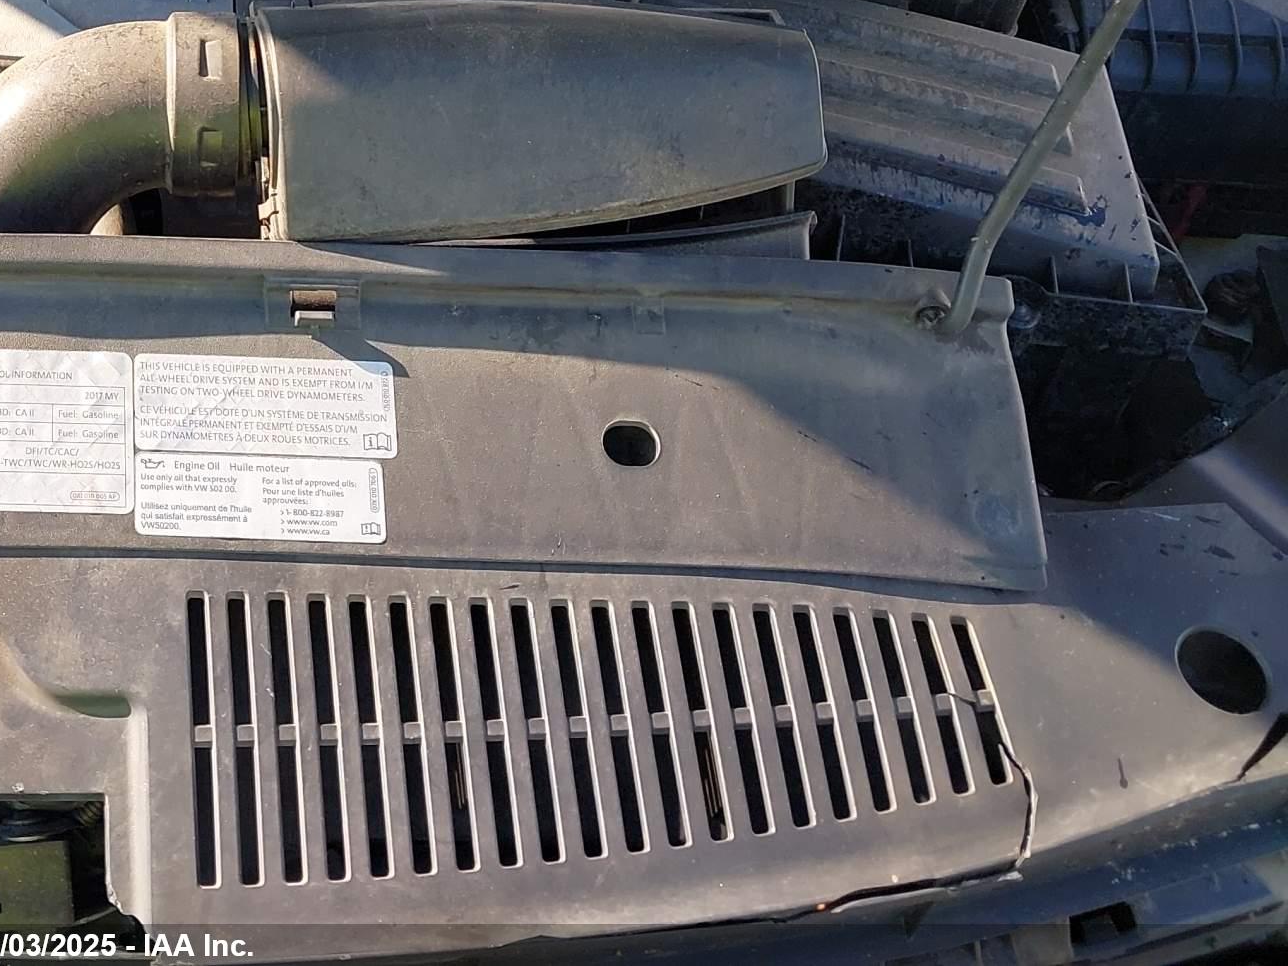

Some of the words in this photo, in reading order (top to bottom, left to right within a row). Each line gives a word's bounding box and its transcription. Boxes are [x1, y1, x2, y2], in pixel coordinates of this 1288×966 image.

[140, 361, 161, 371] THIS
[162, 362, 200, 372] VEHICLE
[202, 363, 210, 372] IS
[212, 363, 259, 374] EQUIPPED
[260, 365, 285, 374] WITH
[287, 366, 294, 375] A
[297, 366, 353, 377] PERMANENT
[11, 370, 73, 380] INFORMATION
[140, 373, 190, 384] ALL-WHEEL
[192, 375, 220, 384] DRIVE
[222, 376, 256, 385] SYSTEM
[258, 377, 279, 386] AND
[281, 378, 290, 387] IS
[292, 378, 327, 388] EXEMPT
[329, 380, 356, 389] FROM
[85, 391, 103, 400] 2017
[105, 392, 120, 400] MY
[140, 385, 178, 395] TESTING
[179, 386, 195, 395] ON
[197, 387, 256, 398] TWO-WHEEL
[257, 389, 285, 399] DRIVE
[287, 390, 366, 402] DYNAMOMETERS.
[15, 408, 28, 416] CA
[58, 409, 77, 419] Fuel:
[82, 410, 119, 420] Gasoline
[139, 405, 152, 414] CE
[306, 411, 319, 420] DE
[320, 411, 387, 422] TRANSMISSION
[189, 419, 242, 430] PERMANENT
[244, 421, 254, 430] ET
[15, 427, 28, 436] CA
[58, 429, 77, 438] Fuel:
[82, 430, 119, 440] Gasoline
[140, 430, 161, 439] SUR
[244, 434, 270, 443] DEUX
[271, 434, 303, 444] ROUES
[174, 460, 205, 472] Engine
[207, 461, 220, 471] Oil
[229, 462, 254, 472] Huile
[256, 464, 290, 473] moteur
[140, 473, 154, 481] Use
[156, 474, 172, 483] only
[202, 475, 237, 485] expressly
[262, 476, 274, 486] For
[282, 477, 293, 485] list
[295, 478, 303, 486] of
[304, 478, 340, 488] approved
[140, 484, 173, 492] complies
[175, 484, 192, 492] with
[262, 487, 279, 495] Pour
[297, 488, 313, 496] liste
[140, 502, 169, 510] Utilisez
[170, 502, 216, 512] uniquement
[218, 504, 228, 512] de
[140, 512, 153, 521] qui
[154, 512, 185, 520] satisfait
[286, 519, 338, 527] www.vw.com
[286, 528, 331, 536] www.vw.ca
